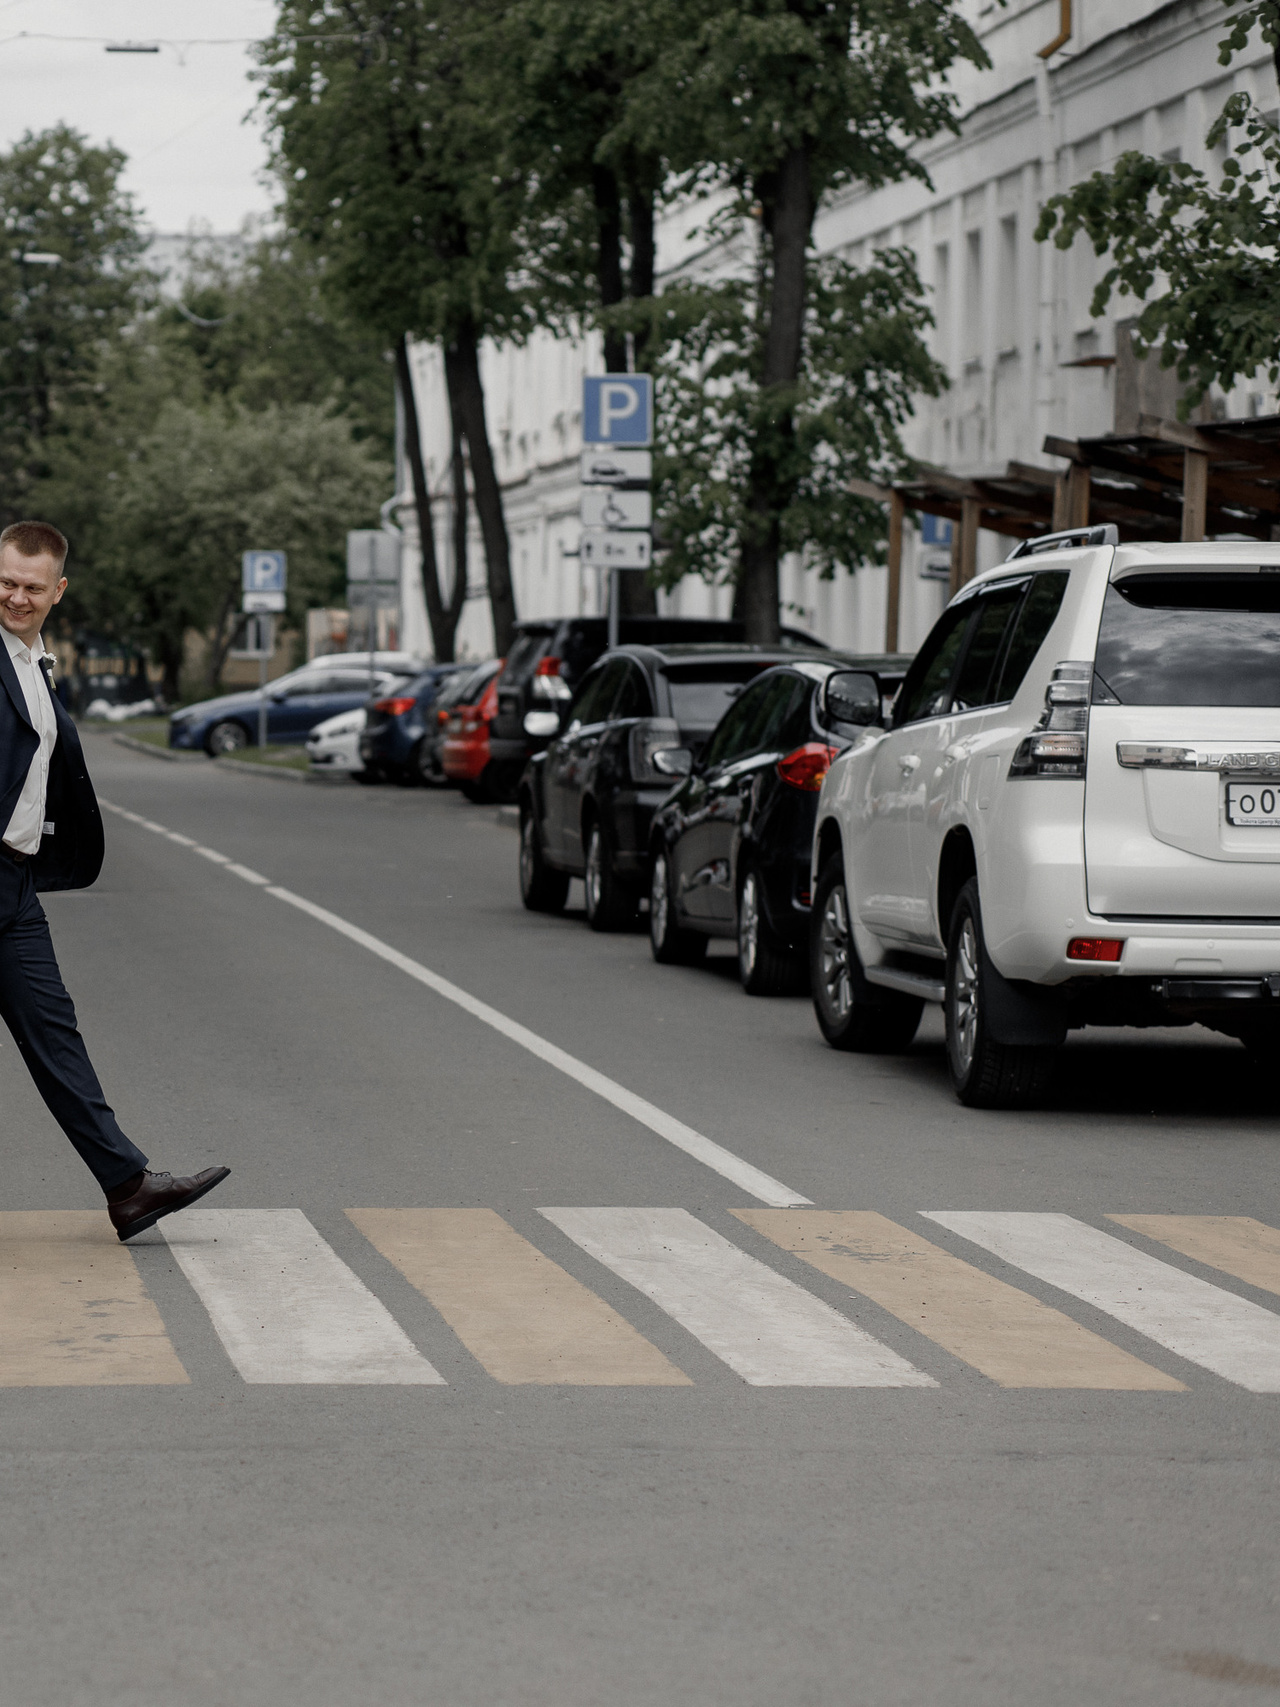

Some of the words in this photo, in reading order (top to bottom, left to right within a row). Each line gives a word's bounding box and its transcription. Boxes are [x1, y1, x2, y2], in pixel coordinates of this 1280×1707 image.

[599, 382, 639, 438] P
[253, 555, 278, 586] P
[1207, 754, 1260, 767] LAND
[1265, 754, 1280, 767] C
[1240, 788, 1280, 814] O0
